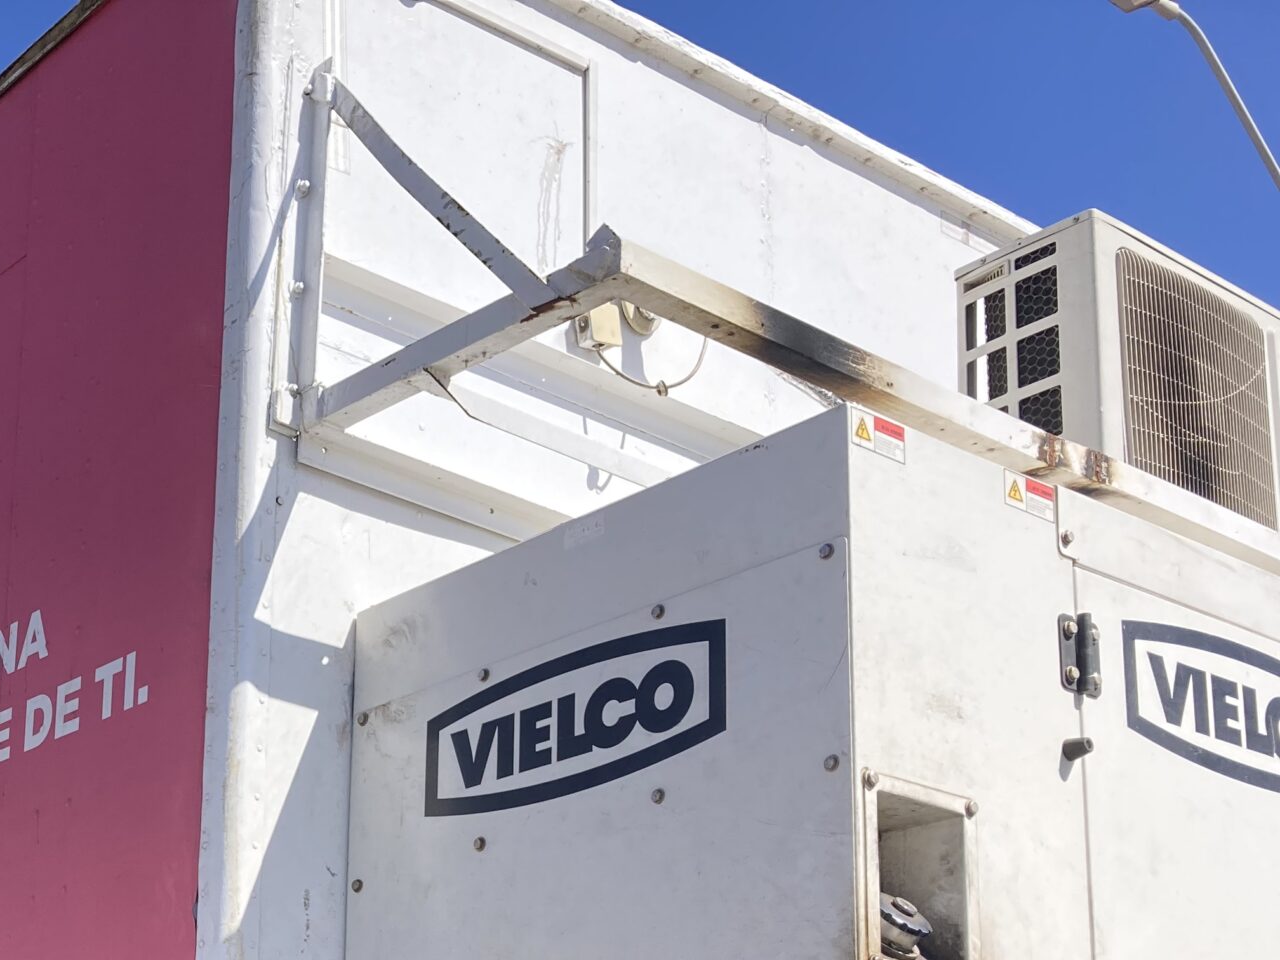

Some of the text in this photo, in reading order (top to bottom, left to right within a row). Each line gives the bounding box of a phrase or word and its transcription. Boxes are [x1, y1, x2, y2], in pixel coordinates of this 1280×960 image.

[24, 676, 81, 752] DE
[94, 651, 148, 720] TI.
[450, 659, 695, 789] VIELCO
